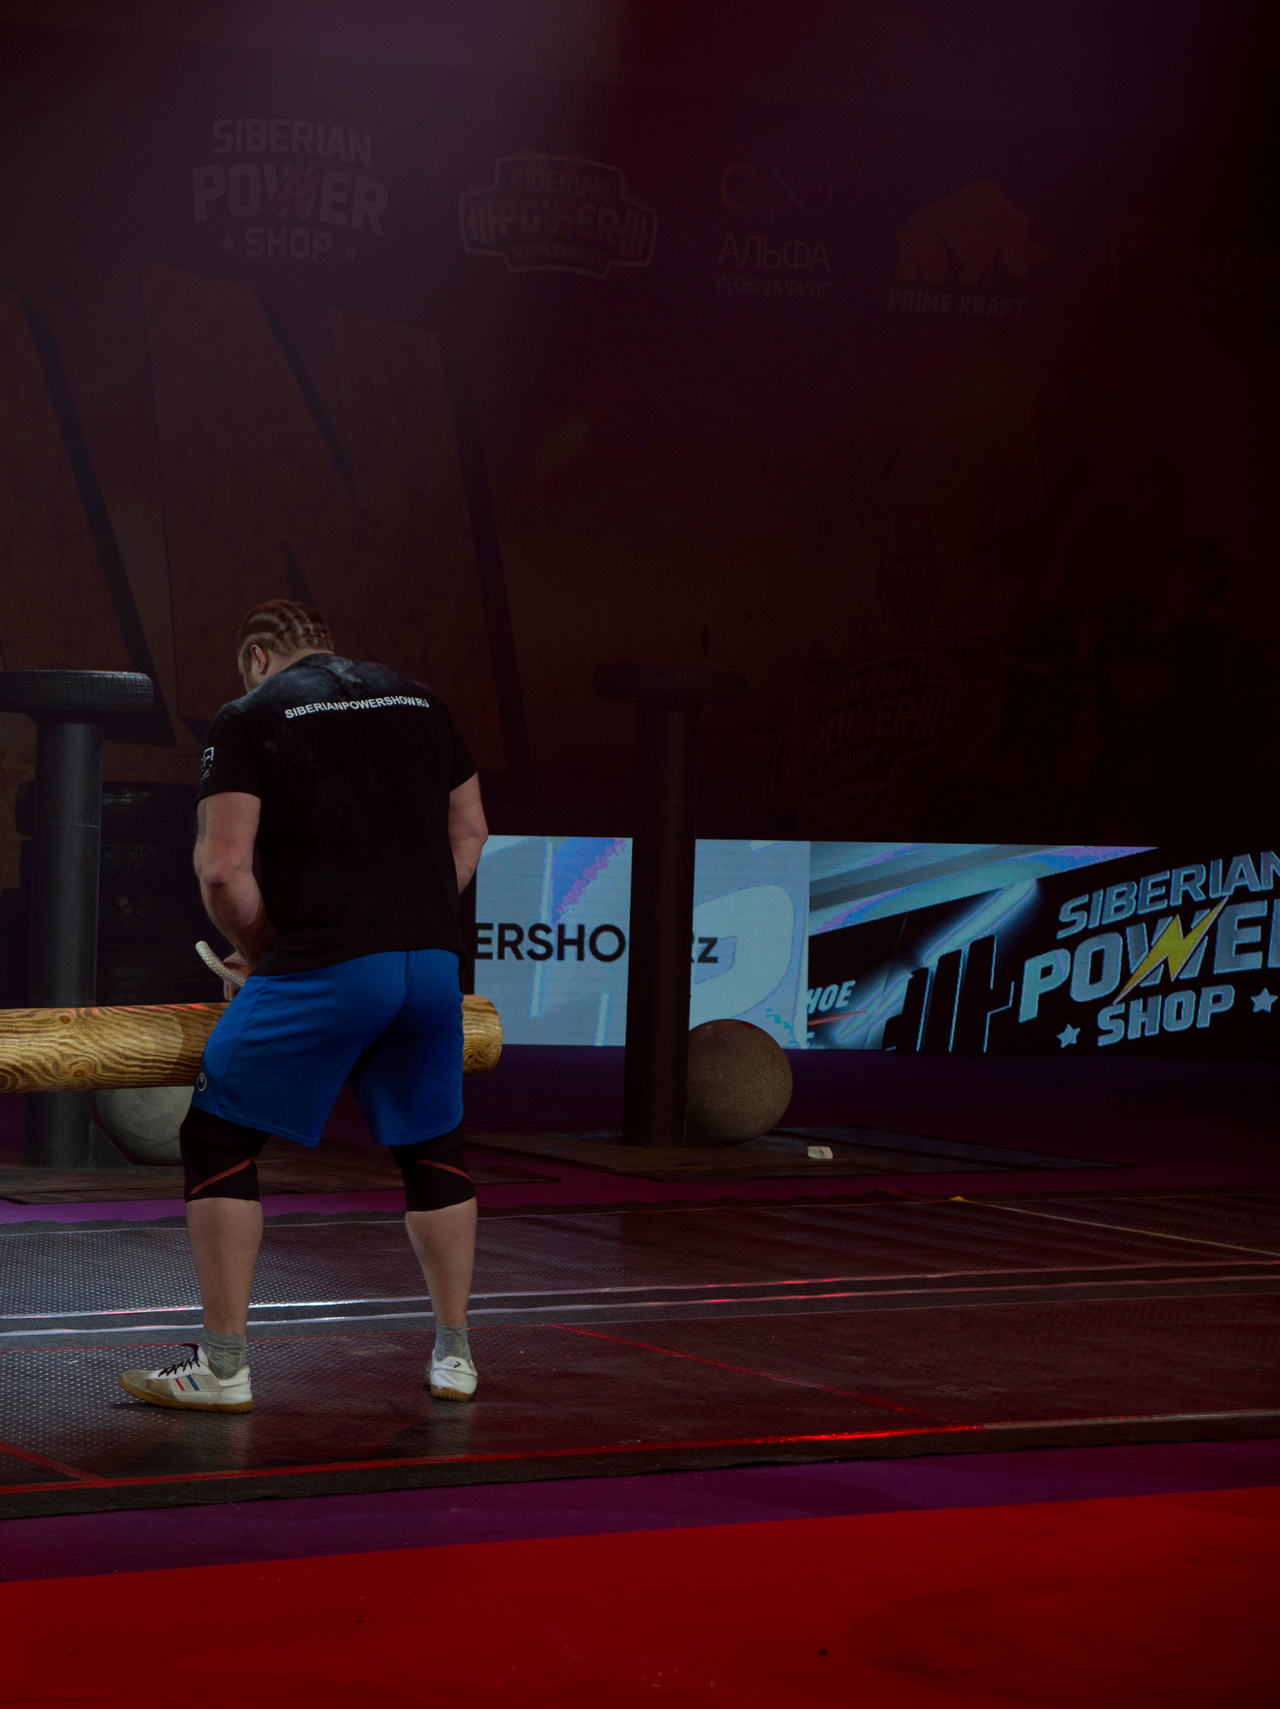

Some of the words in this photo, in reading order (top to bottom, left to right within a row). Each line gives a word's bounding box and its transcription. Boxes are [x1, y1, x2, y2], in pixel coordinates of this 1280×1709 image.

[211, 117, 373, 168] SIBERIAN
[191, 162, 389, 237] POWER
[510, 169, 611, 203] SIBERIAN
[244, 226, 334, 262] SHOP
[717, 233, 832, 275] АЛЬФА
[886, 288, 951, 315] PRIME
[957, 294, 1030, 320] KRAFT
[1096, 983, 1236, 1048] SHOP
